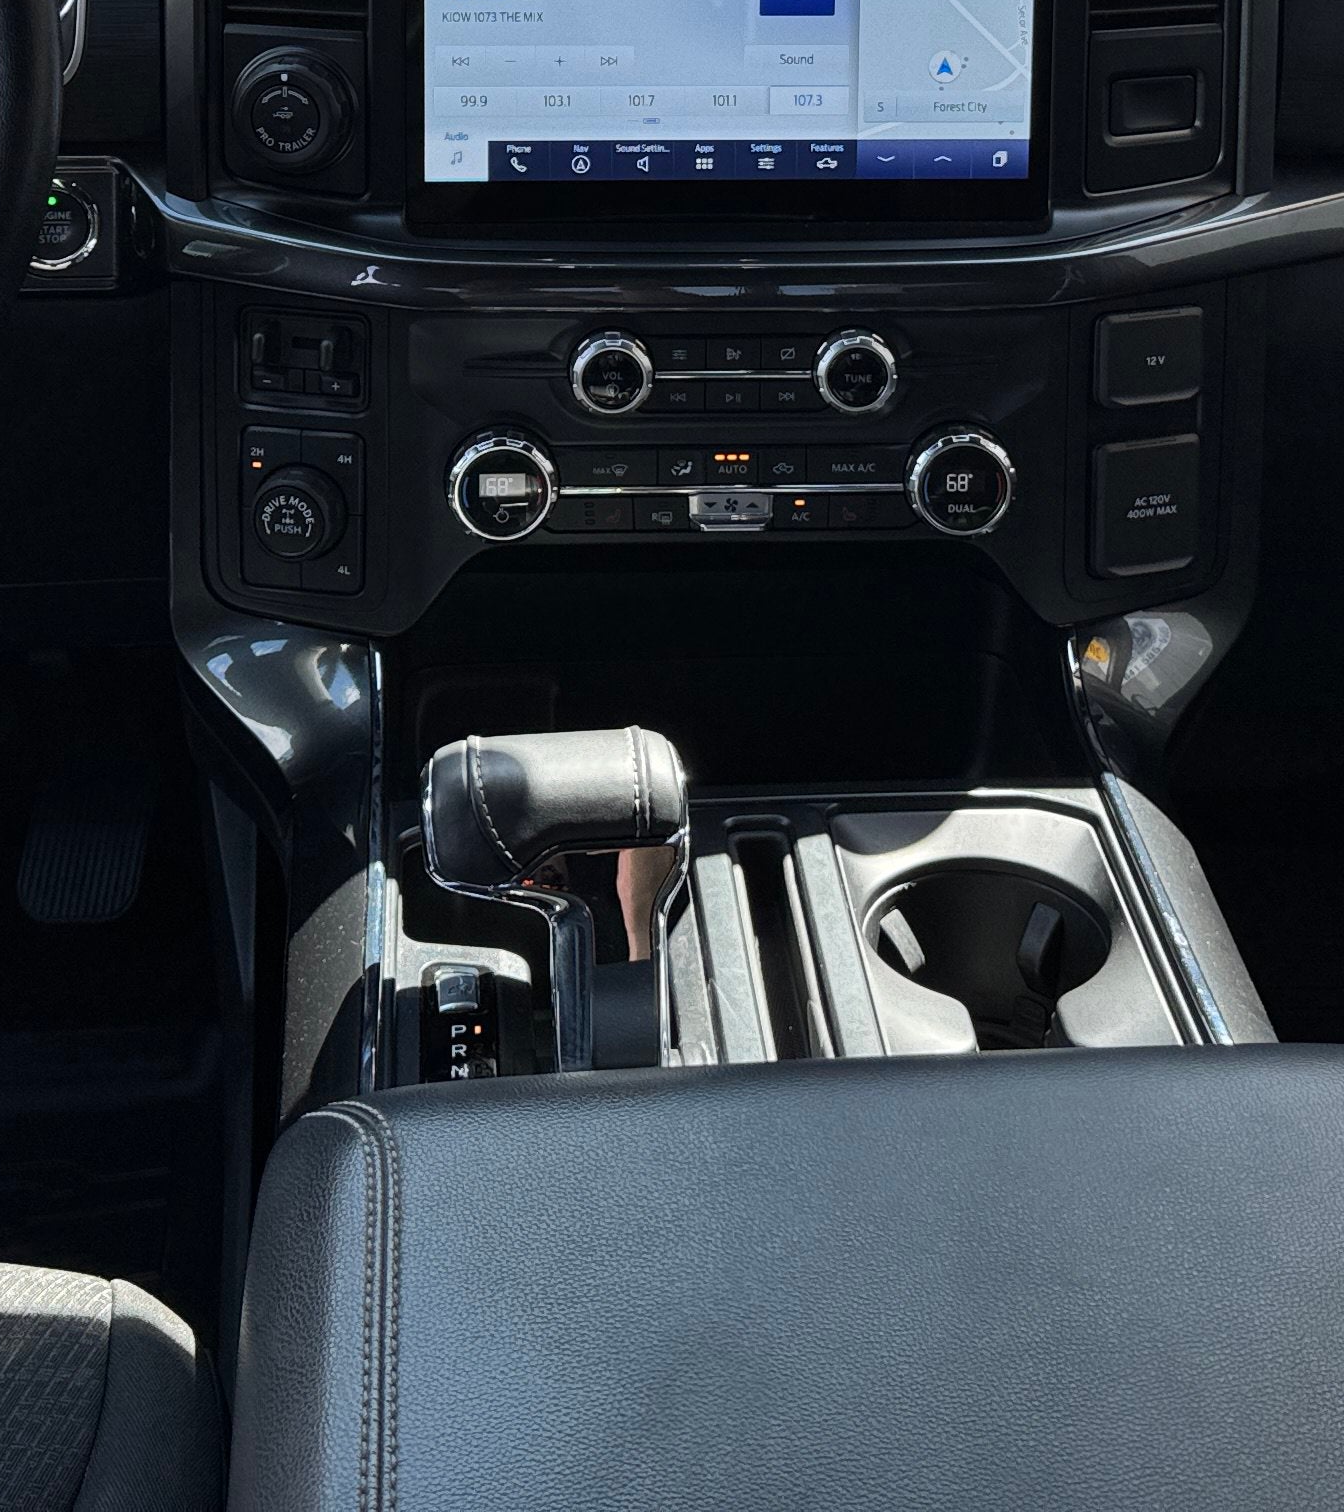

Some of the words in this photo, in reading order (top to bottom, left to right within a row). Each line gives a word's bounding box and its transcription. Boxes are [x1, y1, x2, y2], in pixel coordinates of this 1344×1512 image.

[442, 11, 472, 23] KIOW
[473, 11, 497, 23] 1073
[499, 11, 522, 23] THE
[523, 11, 544, 23] MIX
[779, 54, 814, 66] Sound
[460, 94, 488, 107] 99.9
[543, 94, 572, 107] 103.1
[628, 94, 655, 107] 101.7
[712, 94, 738, 107] 101.1
[793, 94, 823, 107] 107.3
[933, 101, 966, 112] Forest
[967, 101, 987, 114] City
[255, 126, 275, 147] PRO
[278, 127, 317, 152] TRAILER
[444, 131, 469, 142] Audio
[506, 143, 532, 154] Phone
[573, 143, 590, 154] Nav
[615, 143, 640, 154] Sound
[695, 143, 716, 156] Apps
[750, 142, 783, 156] Settings
[810, 143, 845, 154] Features
[602, 371, 623, 381] VOL
[844, 373, 873, 383] TUNE
[250, 447, 265, 457] 2H
[336, 454, 353, 464] 4H
[718, 464, 748, 474] AUTO
[831, 463, 855, 473] MAX
[858, 463, 876, 473] A/C
[946, 473, 974, 492] 68°
[1134, 497, 1148, 507] AC
[1149, 494, 1171, 505] 120V
[261, 495, 287, 522] DRIVE
[288, 495, 316, 525] MODE
[947, 504, 977, 514] DUAL
[1126, 507, 1155, 519] 400W
[1156, 504, 1177, 516] MAX
[792, 511, 811, 522] A/C
[274, 524, 302, 535] PUSH
[337, 566, 351, 575] 4L
[451, 1024, 467, 1038] P
[451, 1044, 467, 1058] R
